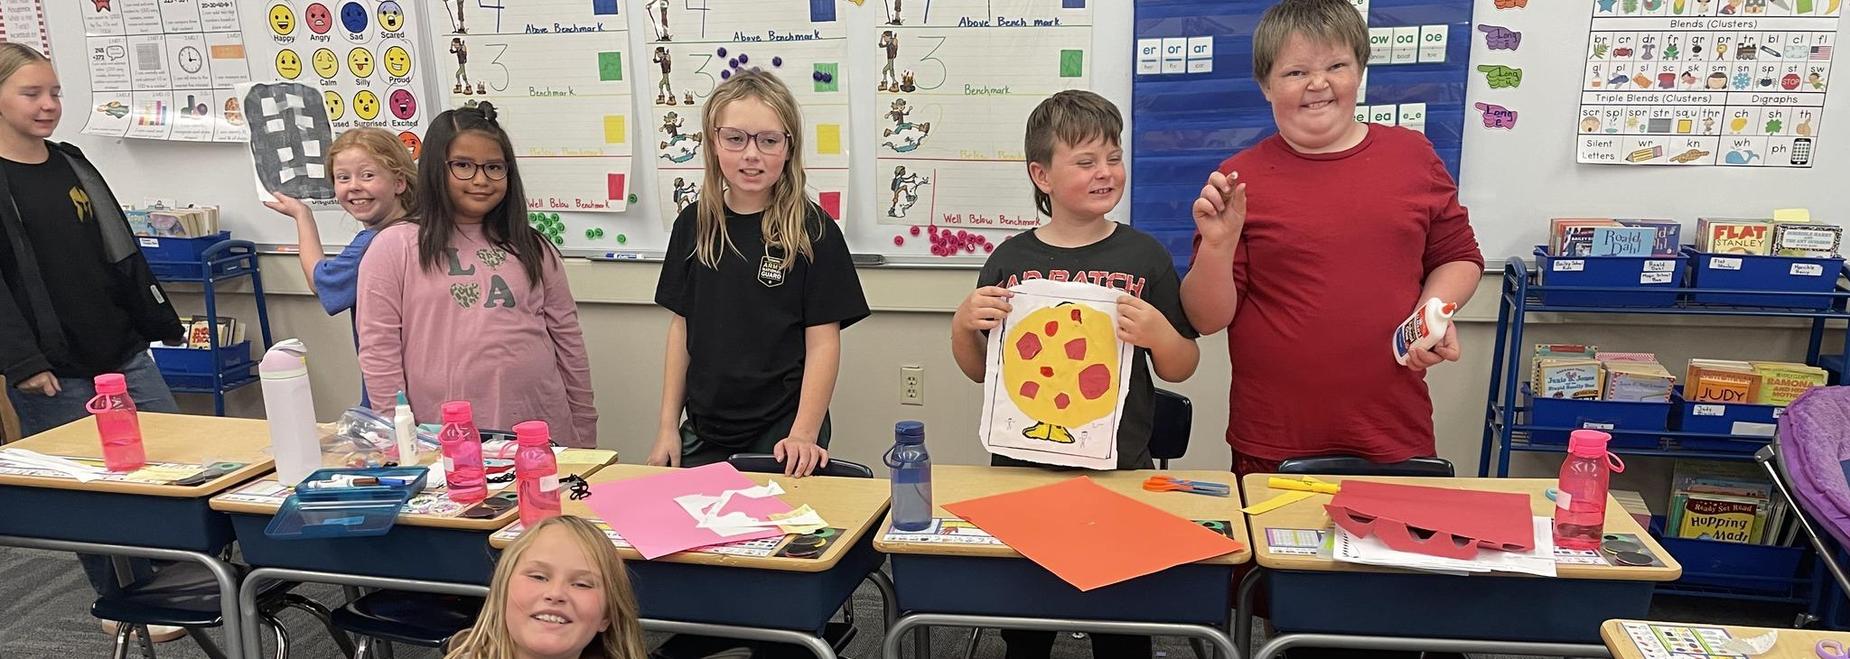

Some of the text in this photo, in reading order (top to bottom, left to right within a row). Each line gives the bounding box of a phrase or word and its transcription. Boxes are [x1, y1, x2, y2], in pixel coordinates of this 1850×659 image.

[958, 17, 990, 27] Above
[998, 17, 1027, 27] Bench
[1670, 20, 1758, 29] Blends (Clusters)
[525, 24, 549, 35] Above
[273, 35, 295, 43] Happy
[310, 34, 331, 42] Angry
[380, 31, 405, 39] Scared
[733, 31, 761, 42] Above
[1370, 35, 1389, 44] ow
[1396, 34, 1414, 43] oa
[1425, 33, 1442, 42] oe
[1496, 28, 1518, 43] Long
[1594, 35, 1607, 44] br
[1642, 35, 1655, 43] dr
[1667, 35, 1679, 43] fr
[1743, 35, 1754, 43] tr
[1768, 35, 1779, 43] bl
[1792, 35, 1804, 44] cl
[1818, 35, 1828, 44] fl
[1691, 36, 1705, 45] gr
[1717, 36, 1731, 45] pr
[1143, 46, 1157, 55] er
[1167, 45, 1181, 54] or
[1193, 44, 1208, 53] ar
[915, 36, 947, 90] 3
[485, 44, 510, 92] 3
[1498, 67, 1519, 78] Long
[1616, 64, 1626, 73] pl
[1640, 64, 1649, 72] sl
[1688, 64, 1699, 72] sk
[1761, 65, 1775, 74] sp
[1788, 64, 1798, 72] st
[389, 76, 411, 84] Proud
[689, 53, 716, 98] 3
[355, 79, 371, 87] Silly
[1595, 93, 1712, 103] Triple Blends (Clusters)
[1752, 95, 1798, 105] Digraphs
[1375, 112, 1391, 121] ea
[1486, 105, 1513, 122] Long
[1606, 108, 1623, 118] spl
[1628, 109, 1647, 118] spr
[1653, 109, 1670, 117] str
[1675, 109, 1697, 118] squ
[1702, 109, 1720, 117] thr
[1734, 110, 1749, 118] ch
[1768, 110, 1782, 118] sh
[1800, 110, 1812, 118] th
[354, 120, 387, 129] Surprised
[1586, 140, 1613, 148] Silent
[1733, 138, 1751, 147] wh
[1771, 144, 1787, 154] ph
[1582, 151, 1615, 160] Letters
[527, 198, 544, 208] Well
[550, 198, 570, 208] Below
[943, 214, 1042, 226] Well Below Benchmark
[1714, 225, 1768, 240] FLAT
[1604, 230, 1641, 246] Roald
[1611, 241, 1641, 256] Dahl
[483, 274, 516, 308] A
[1767, 378, 1814, 387] RAMONA
[1699, 387, 1746, 401] JUDY
[1694, 503, 1716, 513] Ready
[1691, 516, 1748, 529] Hopping
